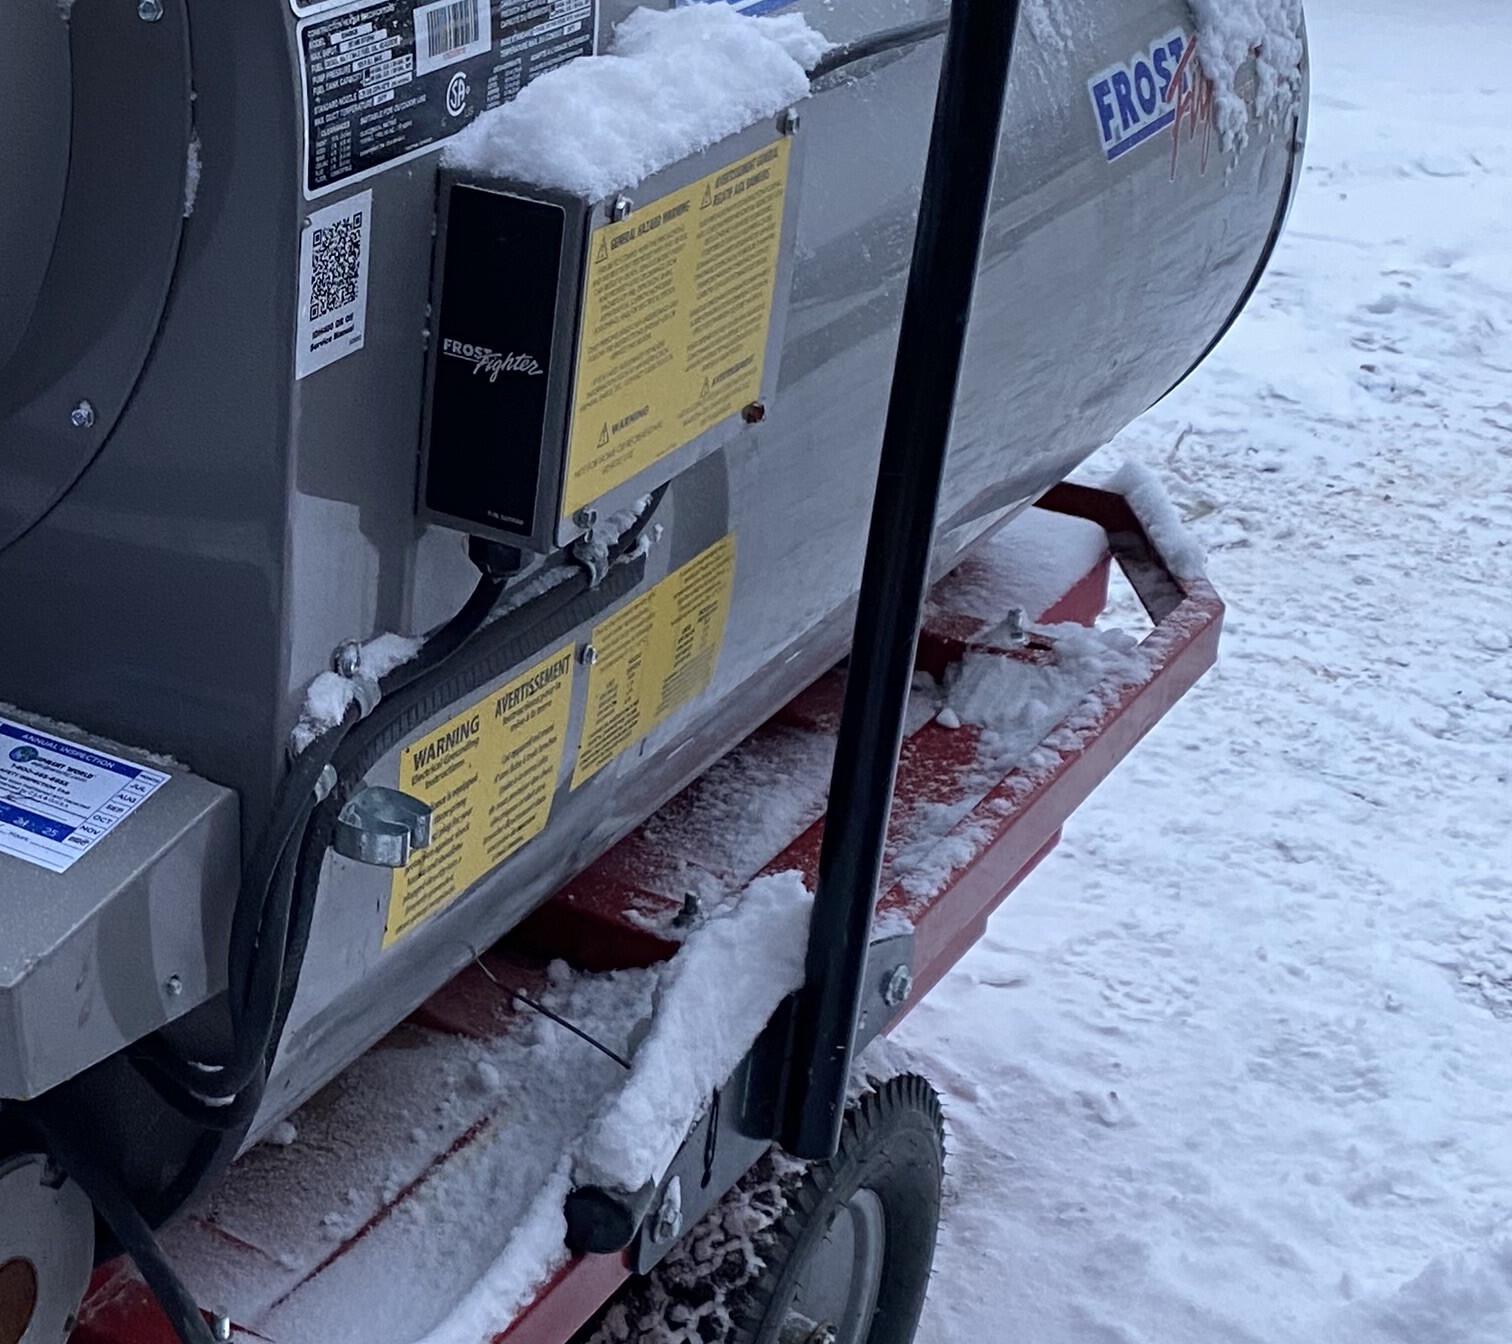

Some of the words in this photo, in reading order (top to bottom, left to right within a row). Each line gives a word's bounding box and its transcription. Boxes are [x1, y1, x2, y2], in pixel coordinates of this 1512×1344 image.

[1093, 36, 1188, 142] FROST
[443, 338, 492, 359] FROST
[473, 351, 543, 383] Fighter
[496, 655, 570, 717] AVERTISSEMENT
[20, 732, 60, 750] ANNUAL
[58, 746, 115, 769] INSPECTION
[413, 714, 480, 771] WARNING
[128, 782, 148, 792] JUL
[411, 757, 443, 786] Electrical
[425, 756, 465, 789] Instructions
[40, 826, 59, 836] 25
[78, 824, 101, 835] NOV
[90, 813, 114, 824] OCT
